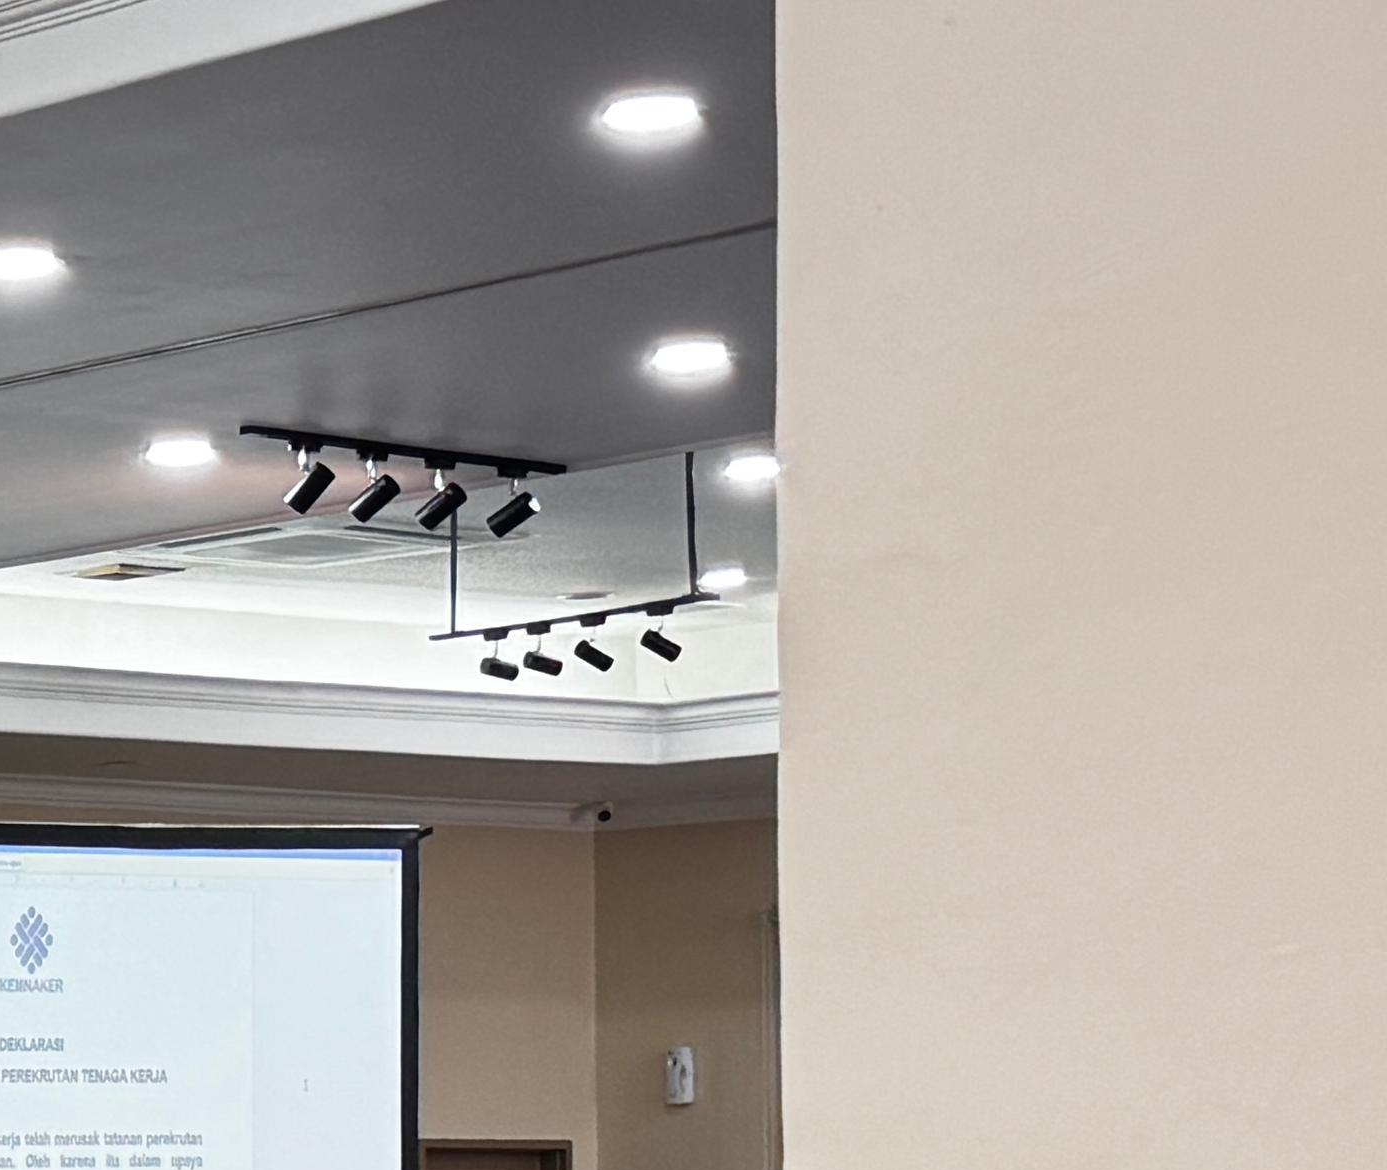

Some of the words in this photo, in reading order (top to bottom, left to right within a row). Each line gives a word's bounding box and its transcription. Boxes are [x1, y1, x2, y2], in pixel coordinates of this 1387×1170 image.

[1, 1068, 78, 1084] PEREKRUTAN
[82, 1068, 127, 1084] TENAGA
[130, 1068, 168, 1084] KERJA
